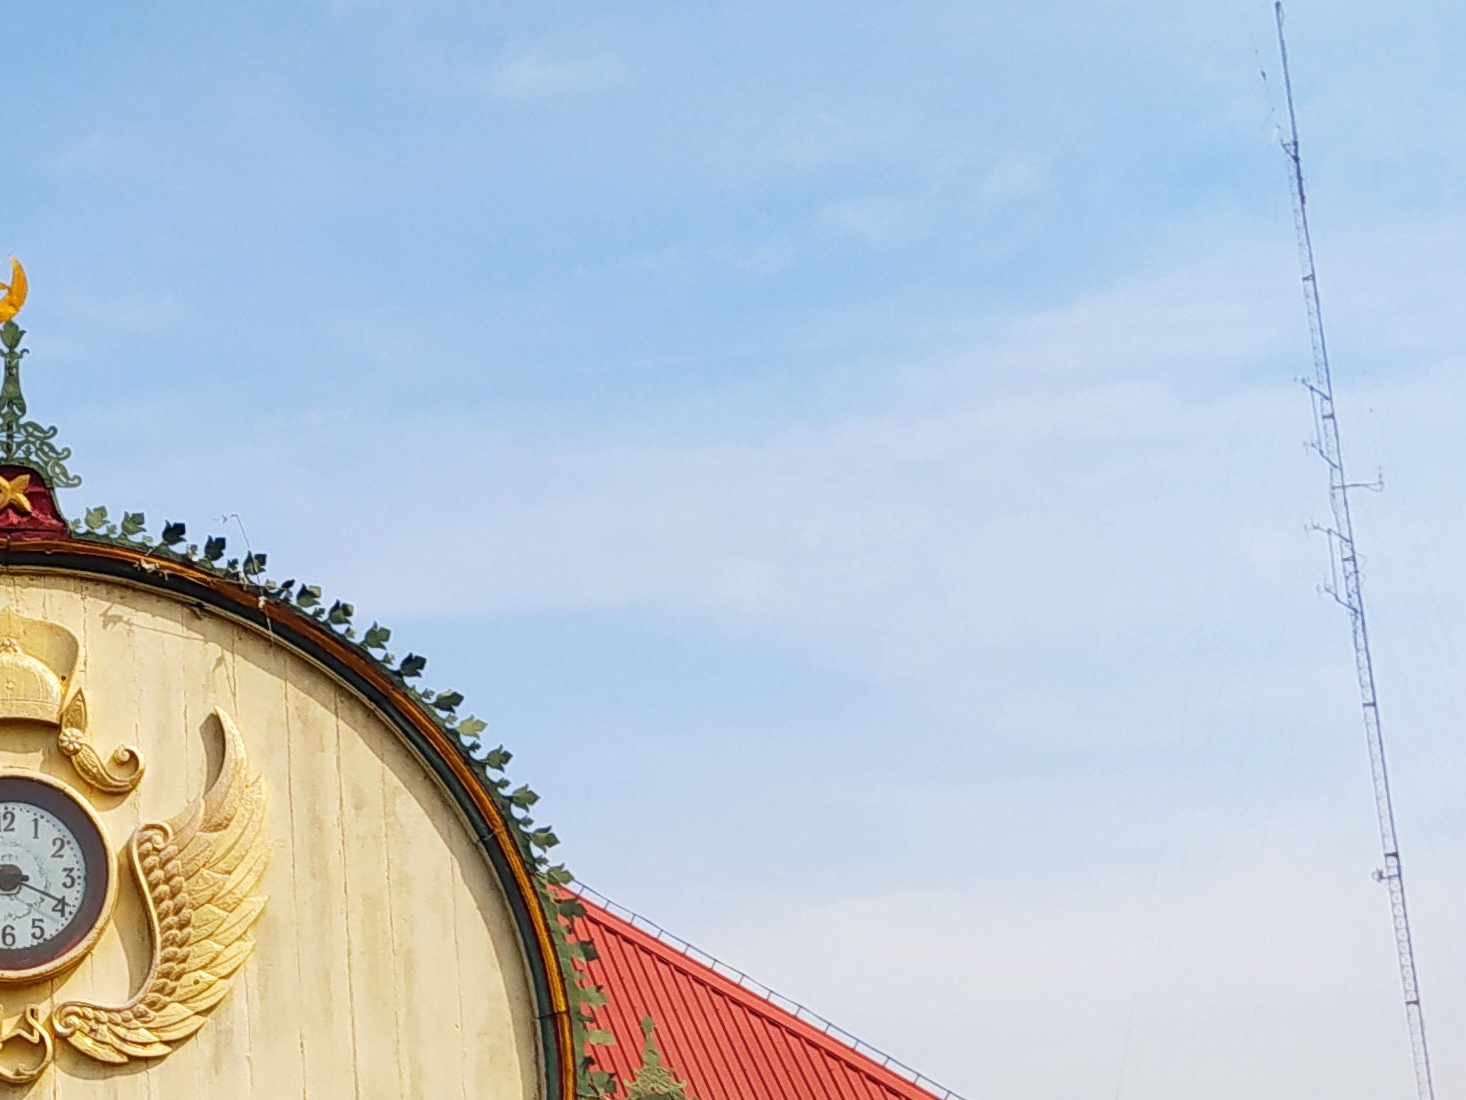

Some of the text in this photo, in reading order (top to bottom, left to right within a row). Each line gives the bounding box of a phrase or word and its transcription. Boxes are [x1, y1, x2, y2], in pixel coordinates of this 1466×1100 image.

[31, 817, 40, 839] 1
[50, 837, 66, 859] 2
[61, 867, 76, 889] 3
[51, 895, 67, 918] 4
[1, 924, 16, 947] 6
[31, 918, 45, 940] 5
